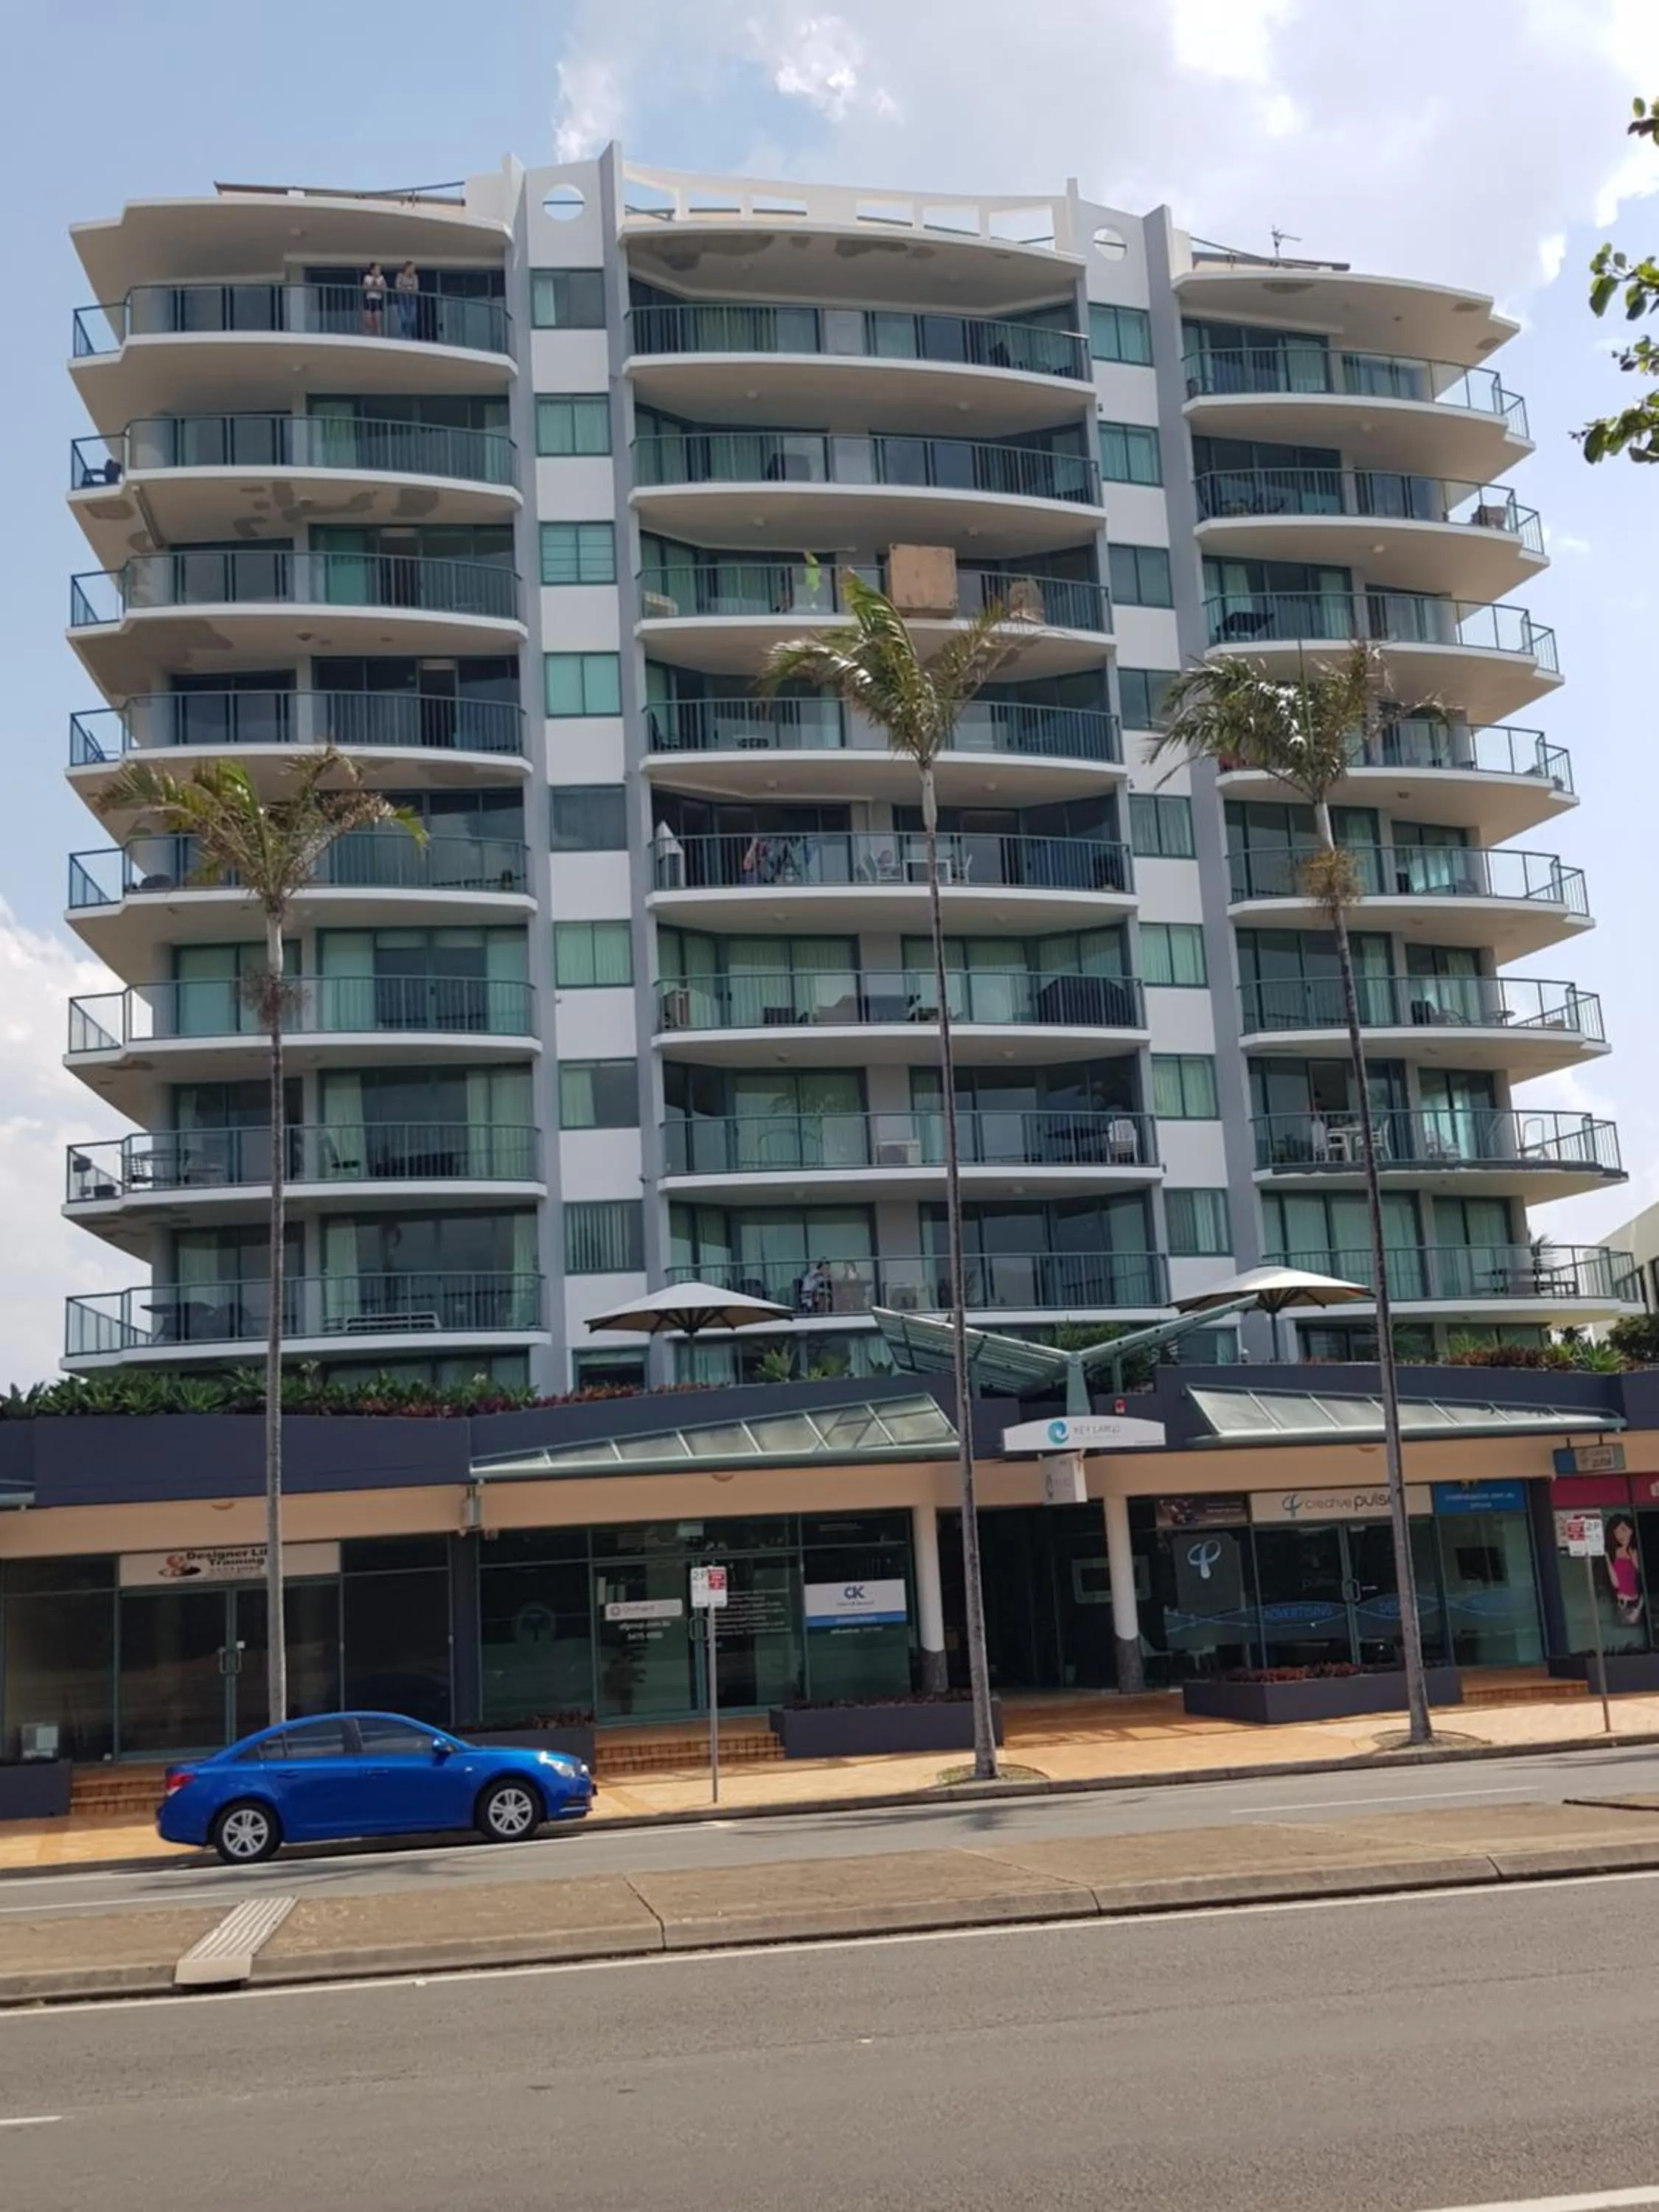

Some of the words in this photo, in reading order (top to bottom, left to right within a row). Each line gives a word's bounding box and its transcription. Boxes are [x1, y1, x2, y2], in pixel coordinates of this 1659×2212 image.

[1304, 1497, 1352, 1509] creative
[1586, 1521, 1600, 1532] 2P
[186, 1549, 248, 1560] Designer
[209, 1557, 265, 1566] Training
